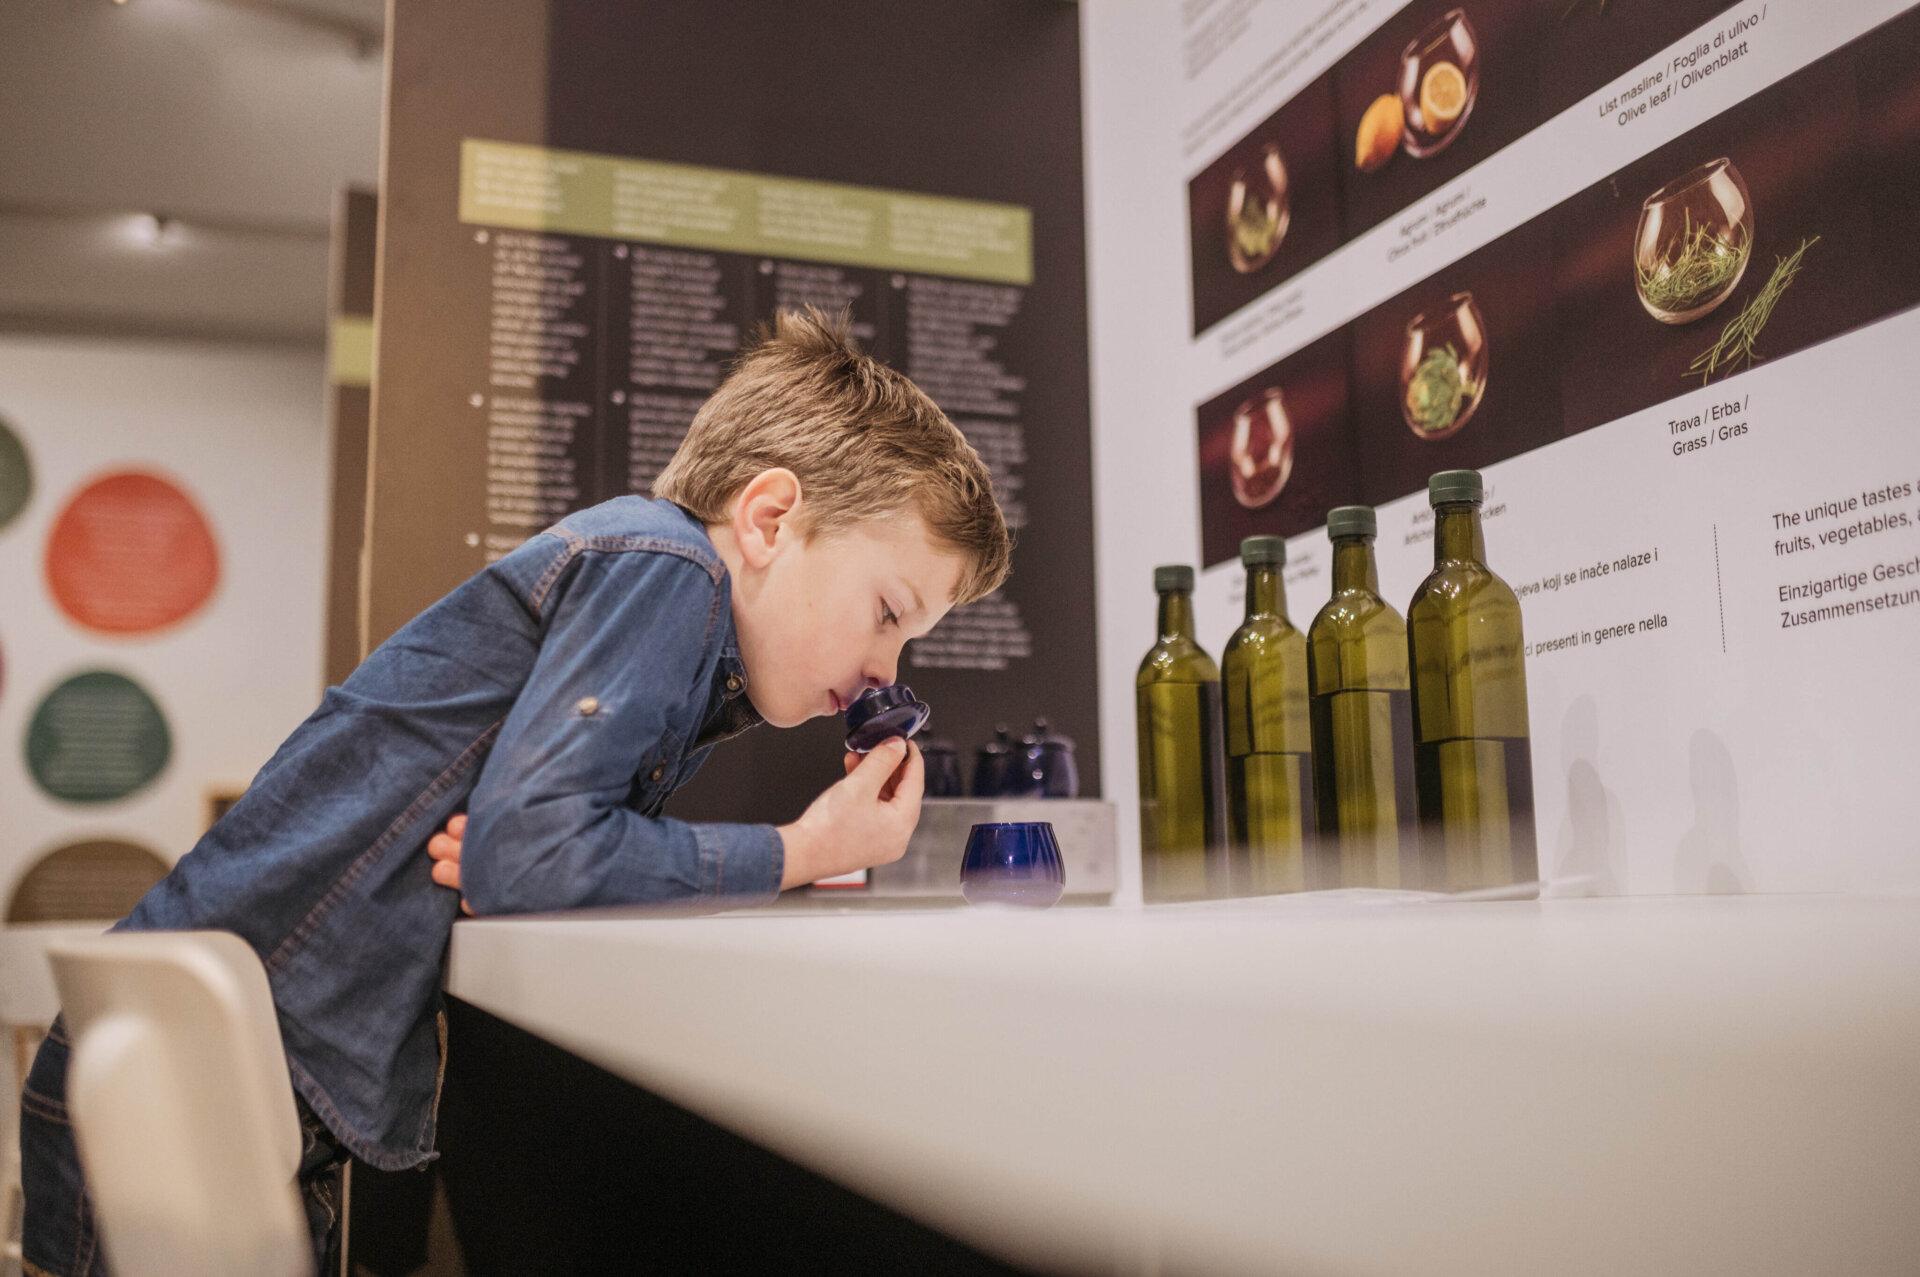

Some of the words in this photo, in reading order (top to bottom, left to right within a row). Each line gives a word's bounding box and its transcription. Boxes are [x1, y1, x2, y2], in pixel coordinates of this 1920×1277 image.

[1599, 96, 1618, 117] List
[1620, 70, 1663, 105] masline
[1673, 43, 1710, 73] Foglia
[1713, 31, 1726, 48] di
[1728, 14, 1759, 40] ulivo
[1618, 102, 1647, 126] Olive
[1650, 86, 1671, 107] leaf
[1681, 40, 1748, 90] Olivenblatt
[1668, 415, 1701, 435] Trava
[1712, 401, 1741, 420] Erba
[1672, 435, 1707, 456] Grass
[1718, 422, 1749, 441] Gras
[1773, 511, 1800, 530] The
[1805, 497, 1858, 523] unique
[1862, 482, 1912, 507] tastes
[1774, 536, 1815, 557] fruits,
[1819, 511, 1912, 545] vegetables,
[1543, 574, 1562, 592] koji
[1564, 572, 1577, 585] se
[1580, 561, 1610, 581] inače
[1613, 552, 1652, 572] nalaze
[1778, 571, 1868, 602] Einzigartige
[1536, 632, 1578, 657] presenti
[1581, 631, 1591, 644] in
[1594, 622, 1635, 645] genere
[1638, 614, 1668, 632] nella
